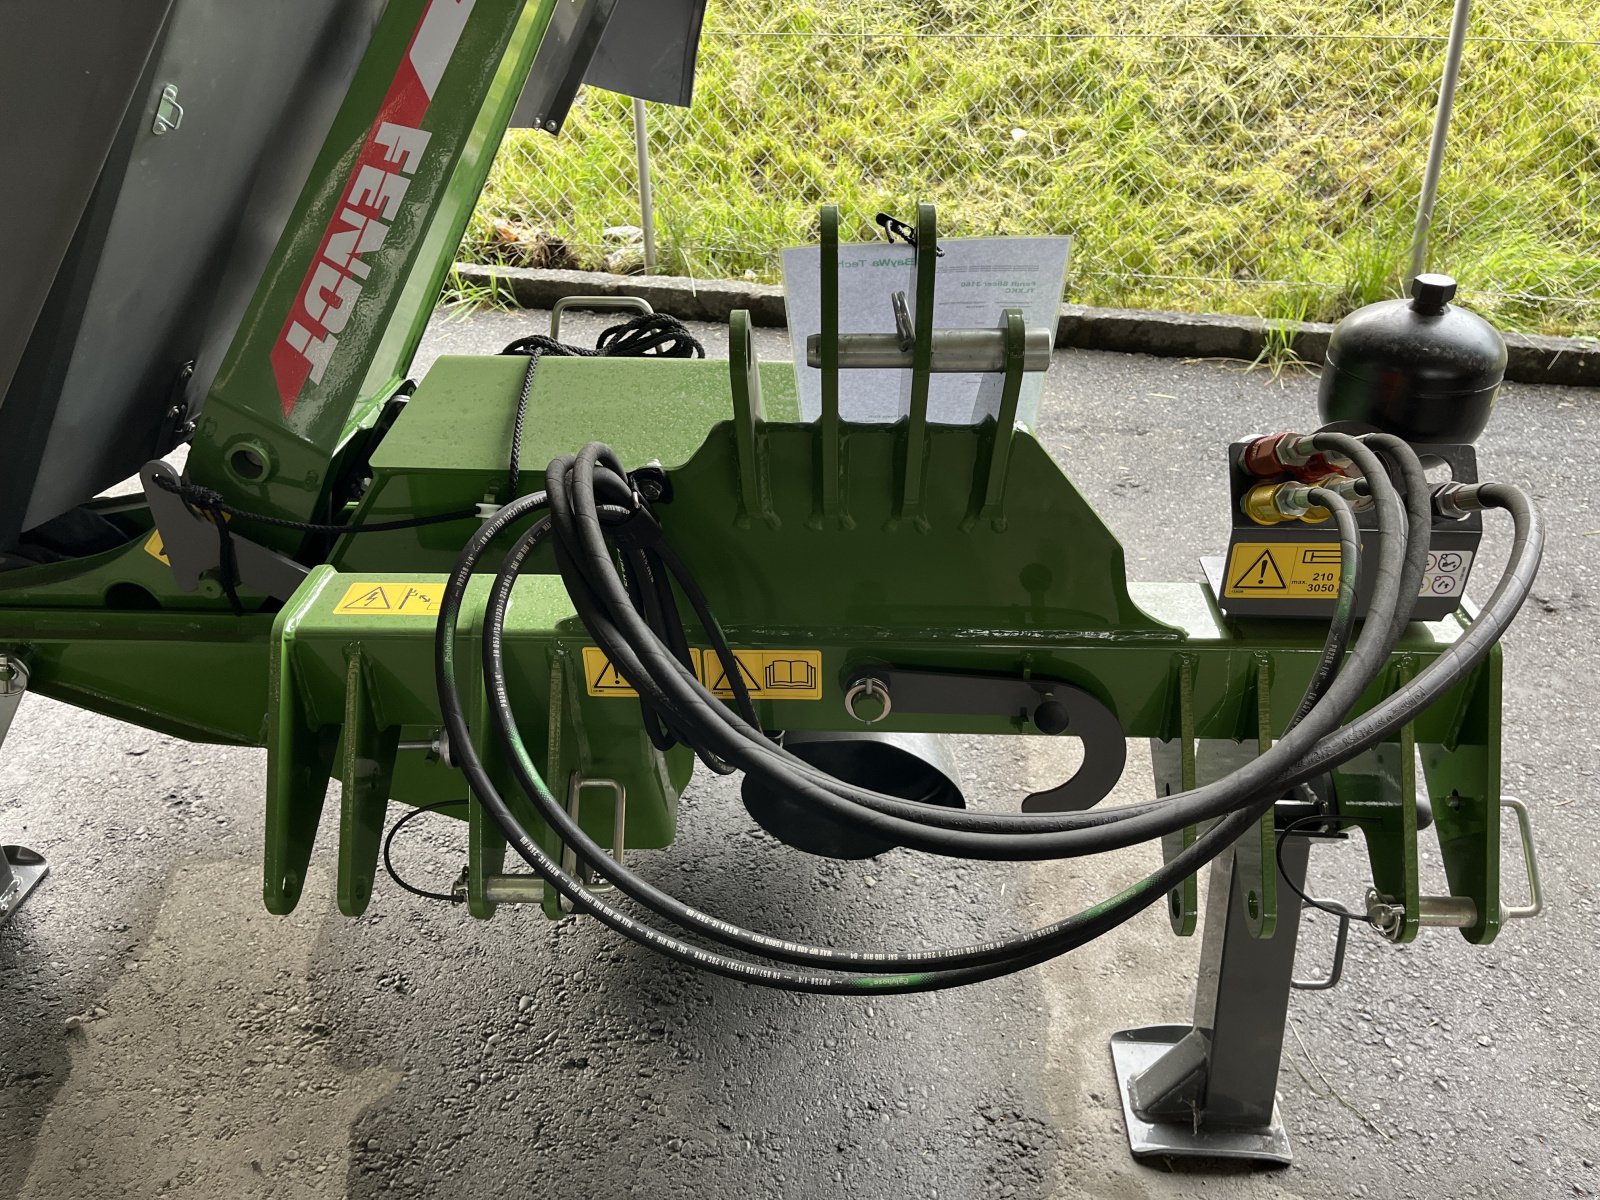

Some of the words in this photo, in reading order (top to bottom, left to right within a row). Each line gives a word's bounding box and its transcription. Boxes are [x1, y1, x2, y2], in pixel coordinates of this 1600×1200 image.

[285, 121, 432, 386] FENDT
[1312, 573, 1334, 581] 210
[1306, 583, 1335, 592] 3050
